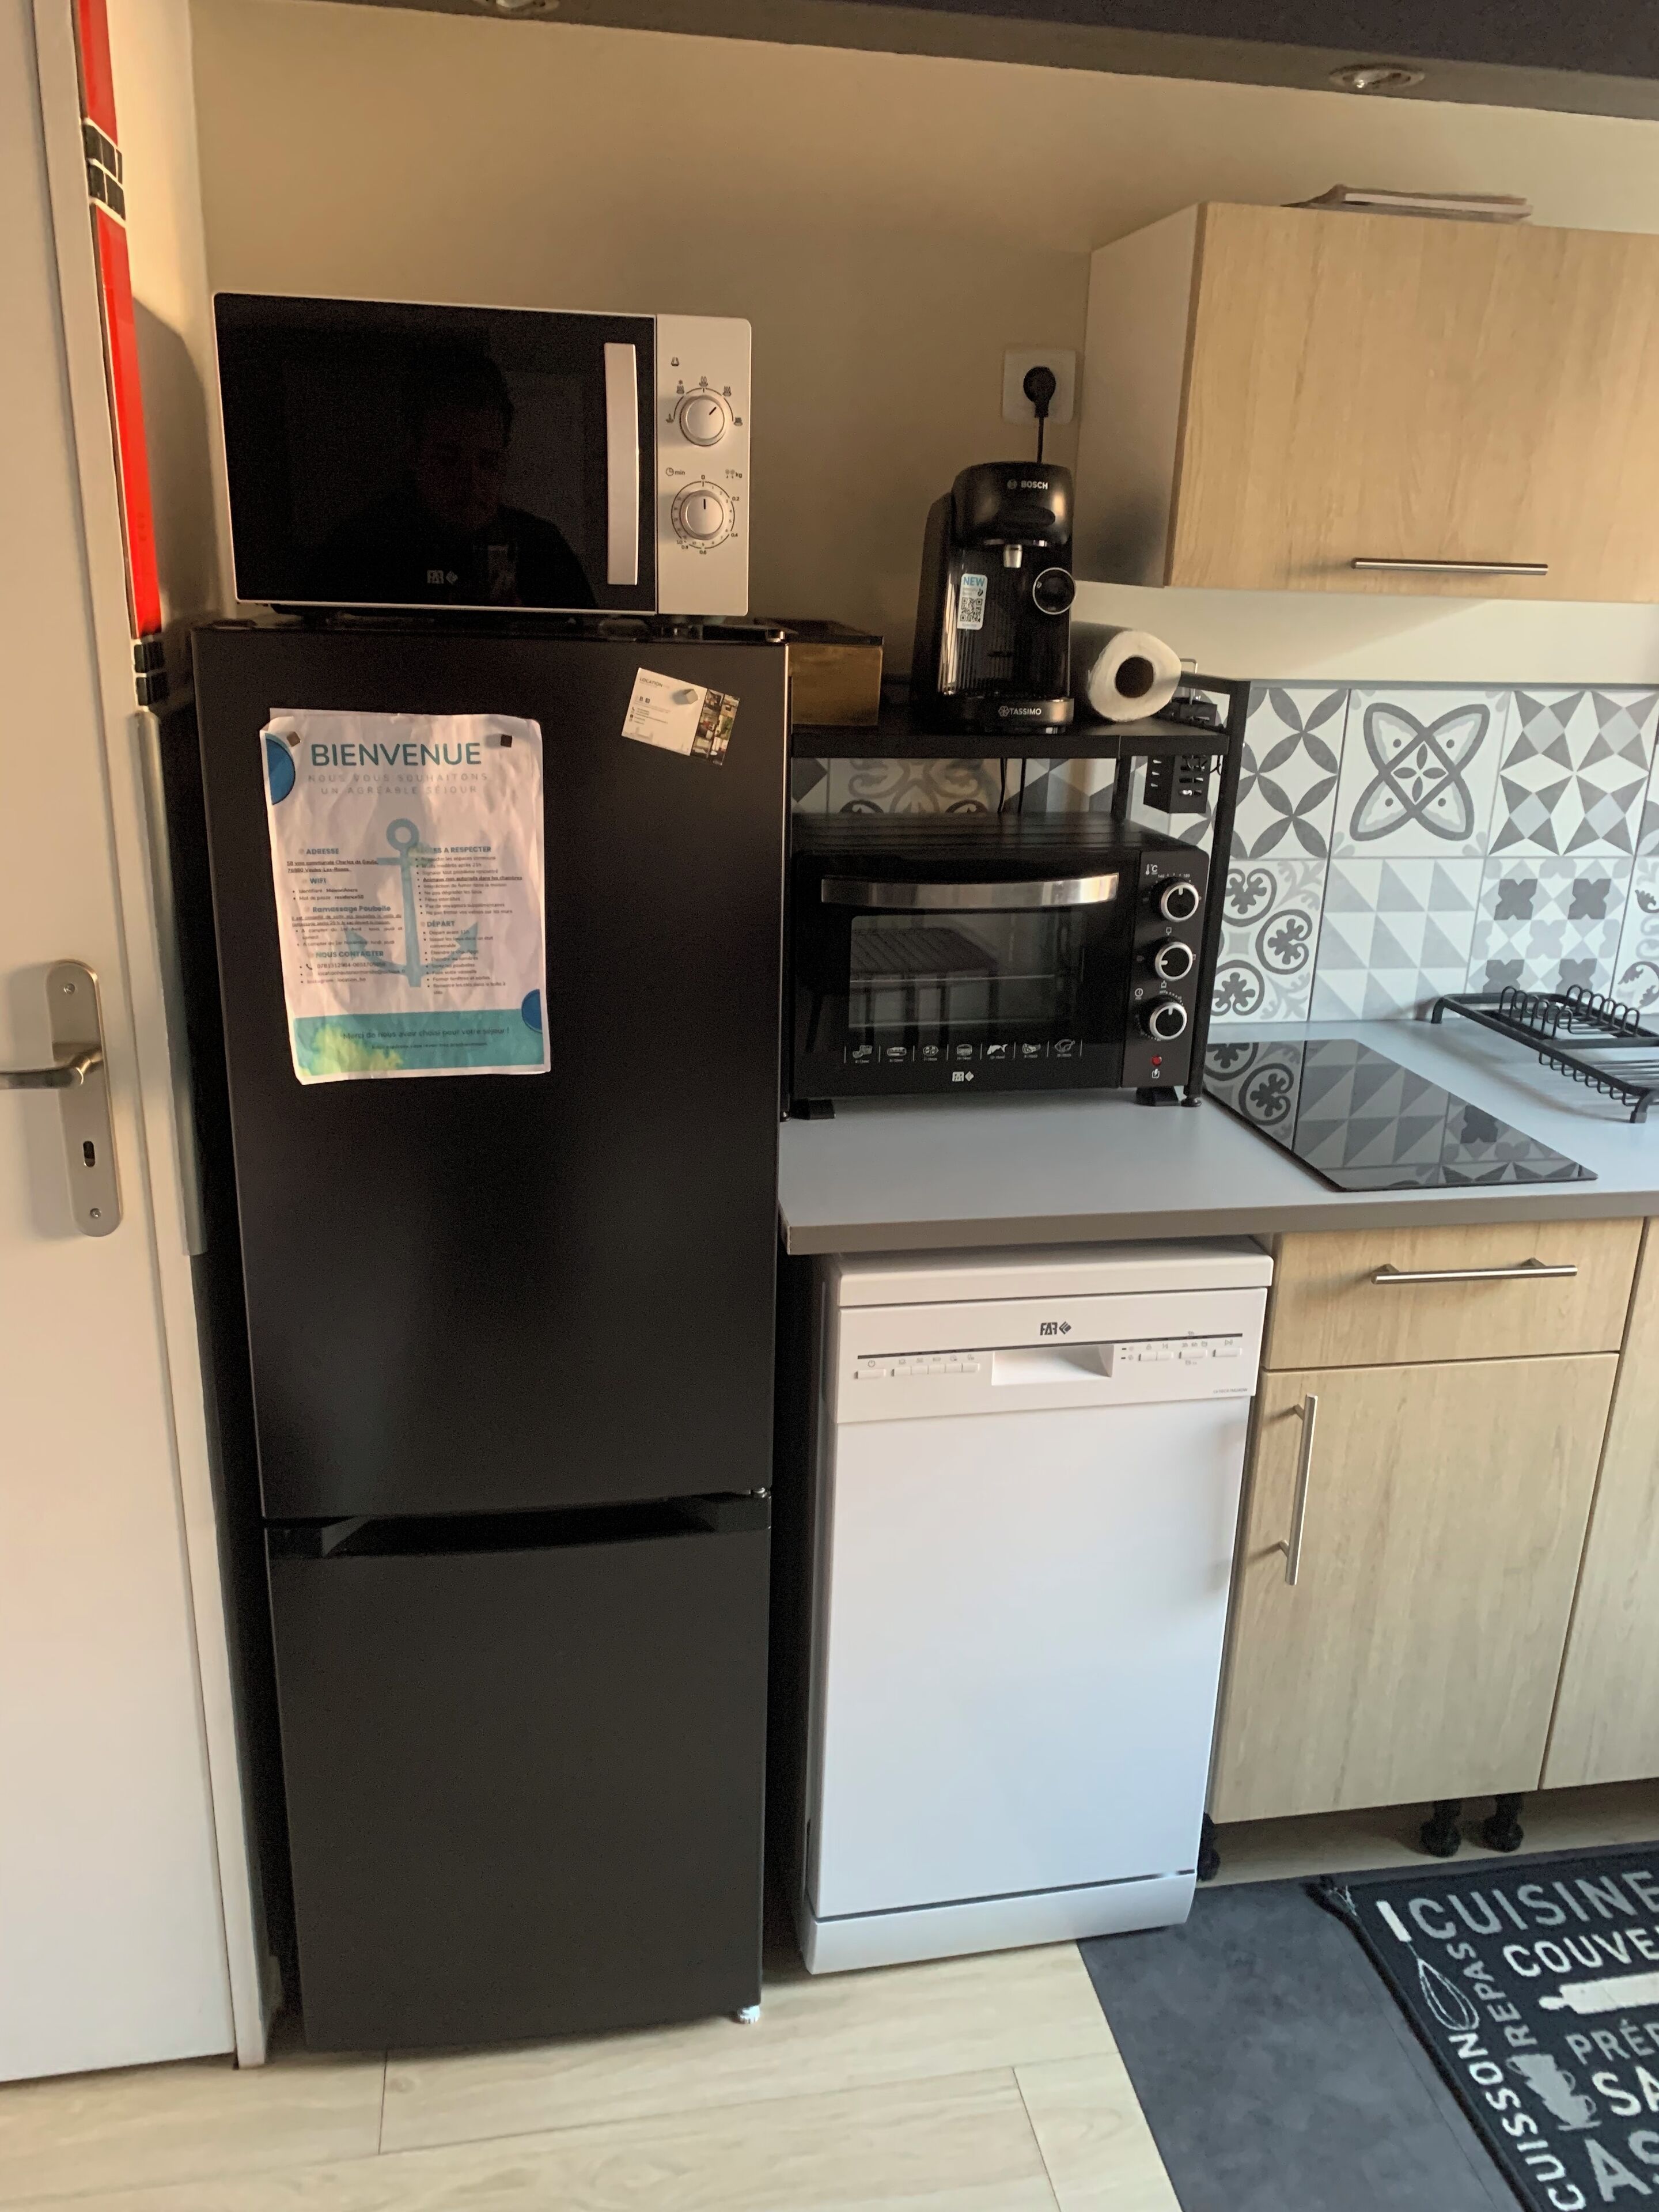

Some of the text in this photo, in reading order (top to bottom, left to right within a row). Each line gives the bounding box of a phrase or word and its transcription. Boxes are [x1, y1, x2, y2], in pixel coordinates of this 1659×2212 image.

[1021, 480, 1048, 490] BOSCH
[963, 577, 985, 586] NEW
[311, 743, 482, 766] BIENVENUE
[308, 773, 487, 783] NOUS VOUS SOUHAITONS
[347, 785, 419, 794] AGRÉABLE
[427, 785, 477, 794] SÉJOUR
[1408, 1870, 1659, 1940] CUISINE
[1503, 1925, 1659, 1977] COUVE
[1446, 1942, 1538, 2048] REPAS
[1448, 2032, 1586, 2212] CUISSON
